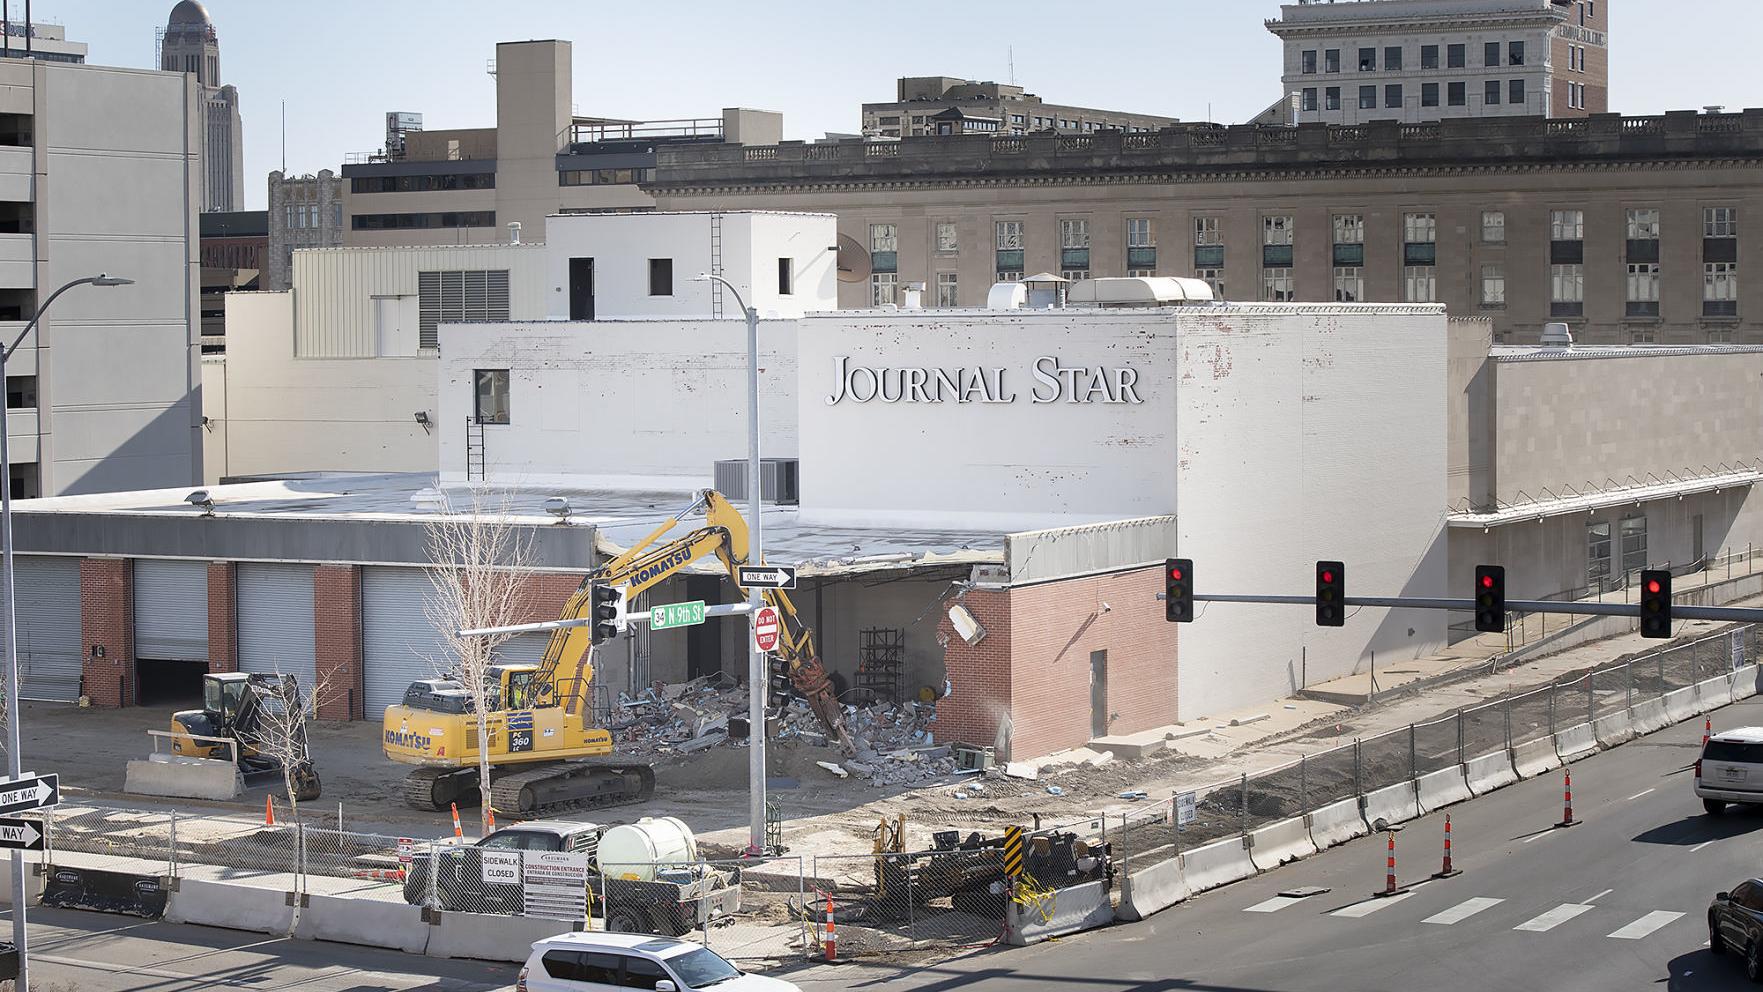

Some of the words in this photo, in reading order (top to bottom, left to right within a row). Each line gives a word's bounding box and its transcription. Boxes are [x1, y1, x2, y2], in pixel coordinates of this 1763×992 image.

[824, 356, 1016, 406] JOURNAL
[1031, 356, 1144, 405] STAR
[630, 545, 692, 588] KOMATSU
[746, 573, 760, 581] ONE
[763, 573, 777, 581] WAY
[655, 612, 665, 624] 34
[668, 607, 675, 624] N
[677, 606, 691, 623] 9th
[692, 604, 702, 621] St
[758, 616, 765, 624] DO
[766, 614, 776, 623] NOT
[760, 635, 775, 643] ENTER
[385, 729, 431, 750] KOMATSU
[512, 737, 529, 746] 360
[2, 792, 18, 804] ONE
[21, 788, 38, 800] WAY
[2, 827, 24, 840] WAY
[483, 856, 518, 865] SIDEWALK
[525, 863, 560, 871] CONSTRUCTION
[487, 869, 515, 878] CLOSED
